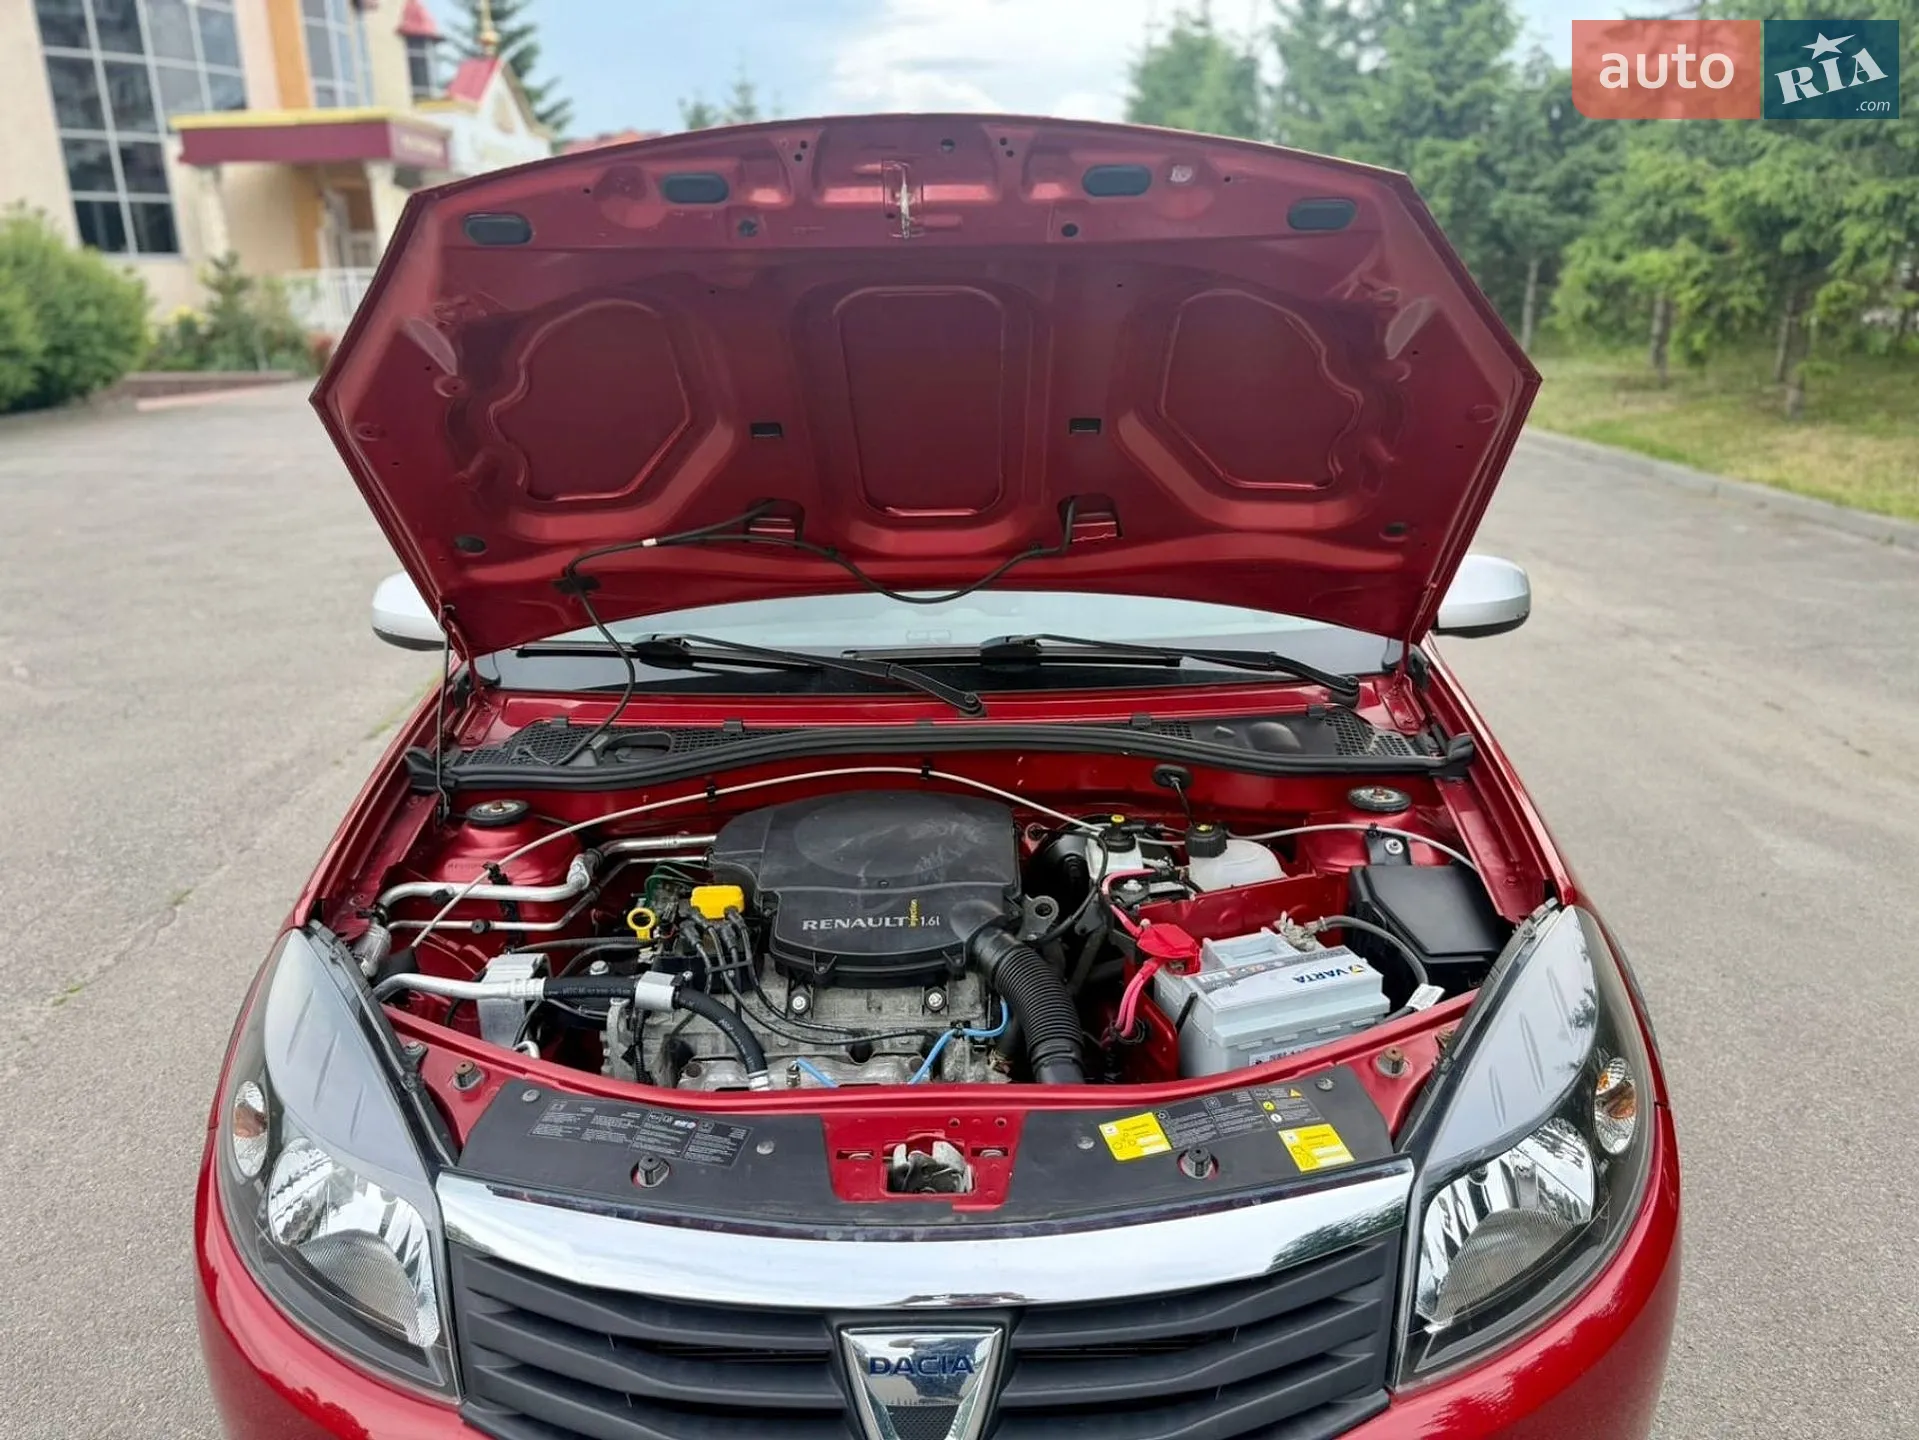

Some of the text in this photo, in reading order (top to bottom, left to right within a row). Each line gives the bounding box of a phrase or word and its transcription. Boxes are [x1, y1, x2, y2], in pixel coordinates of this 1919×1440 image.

[803, 916, 907, 930] RENAULT
[1292, 968, 1350, 983] VARTA
[869, 1356, 975, 1376] DACIA
